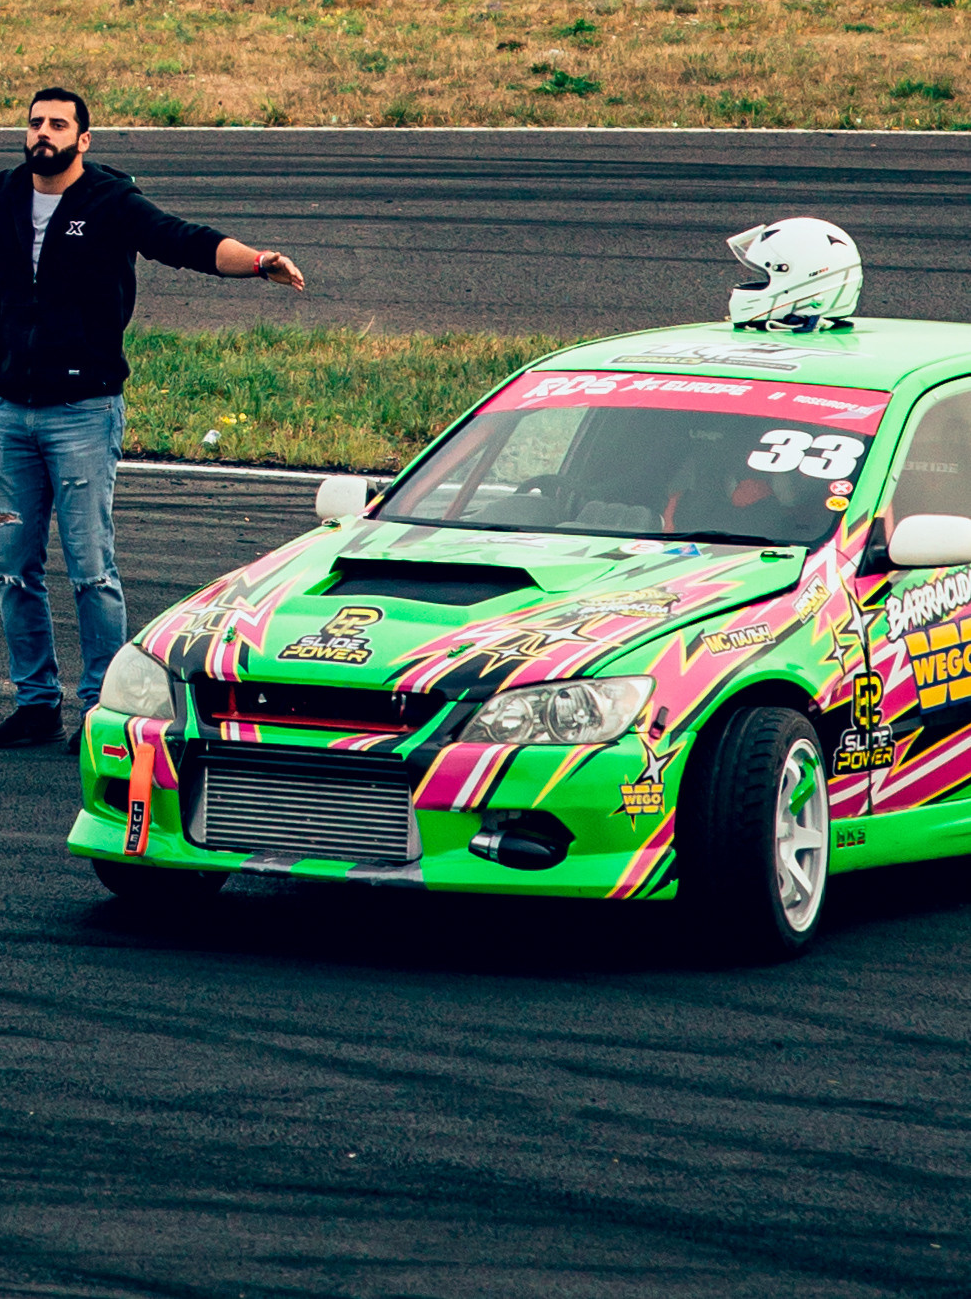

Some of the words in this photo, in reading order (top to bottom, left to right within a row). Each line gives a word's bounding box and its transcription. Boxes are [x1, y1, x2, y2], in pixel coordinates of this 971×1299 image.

[522, 375, 632, 398] RDS
[659, 381, 753, 396] EUROPE
[747, 429, 865, 479] 33
[283, 645, 369, 662] POWER
[300, 637, 366, 650] SLIDE
[845, 730, 890, 752] SLIDE
[837, 748, 893, 771] POWER
[623, 793, 662, 805] WEGO
[130, 803, 143, 842] LUKE
